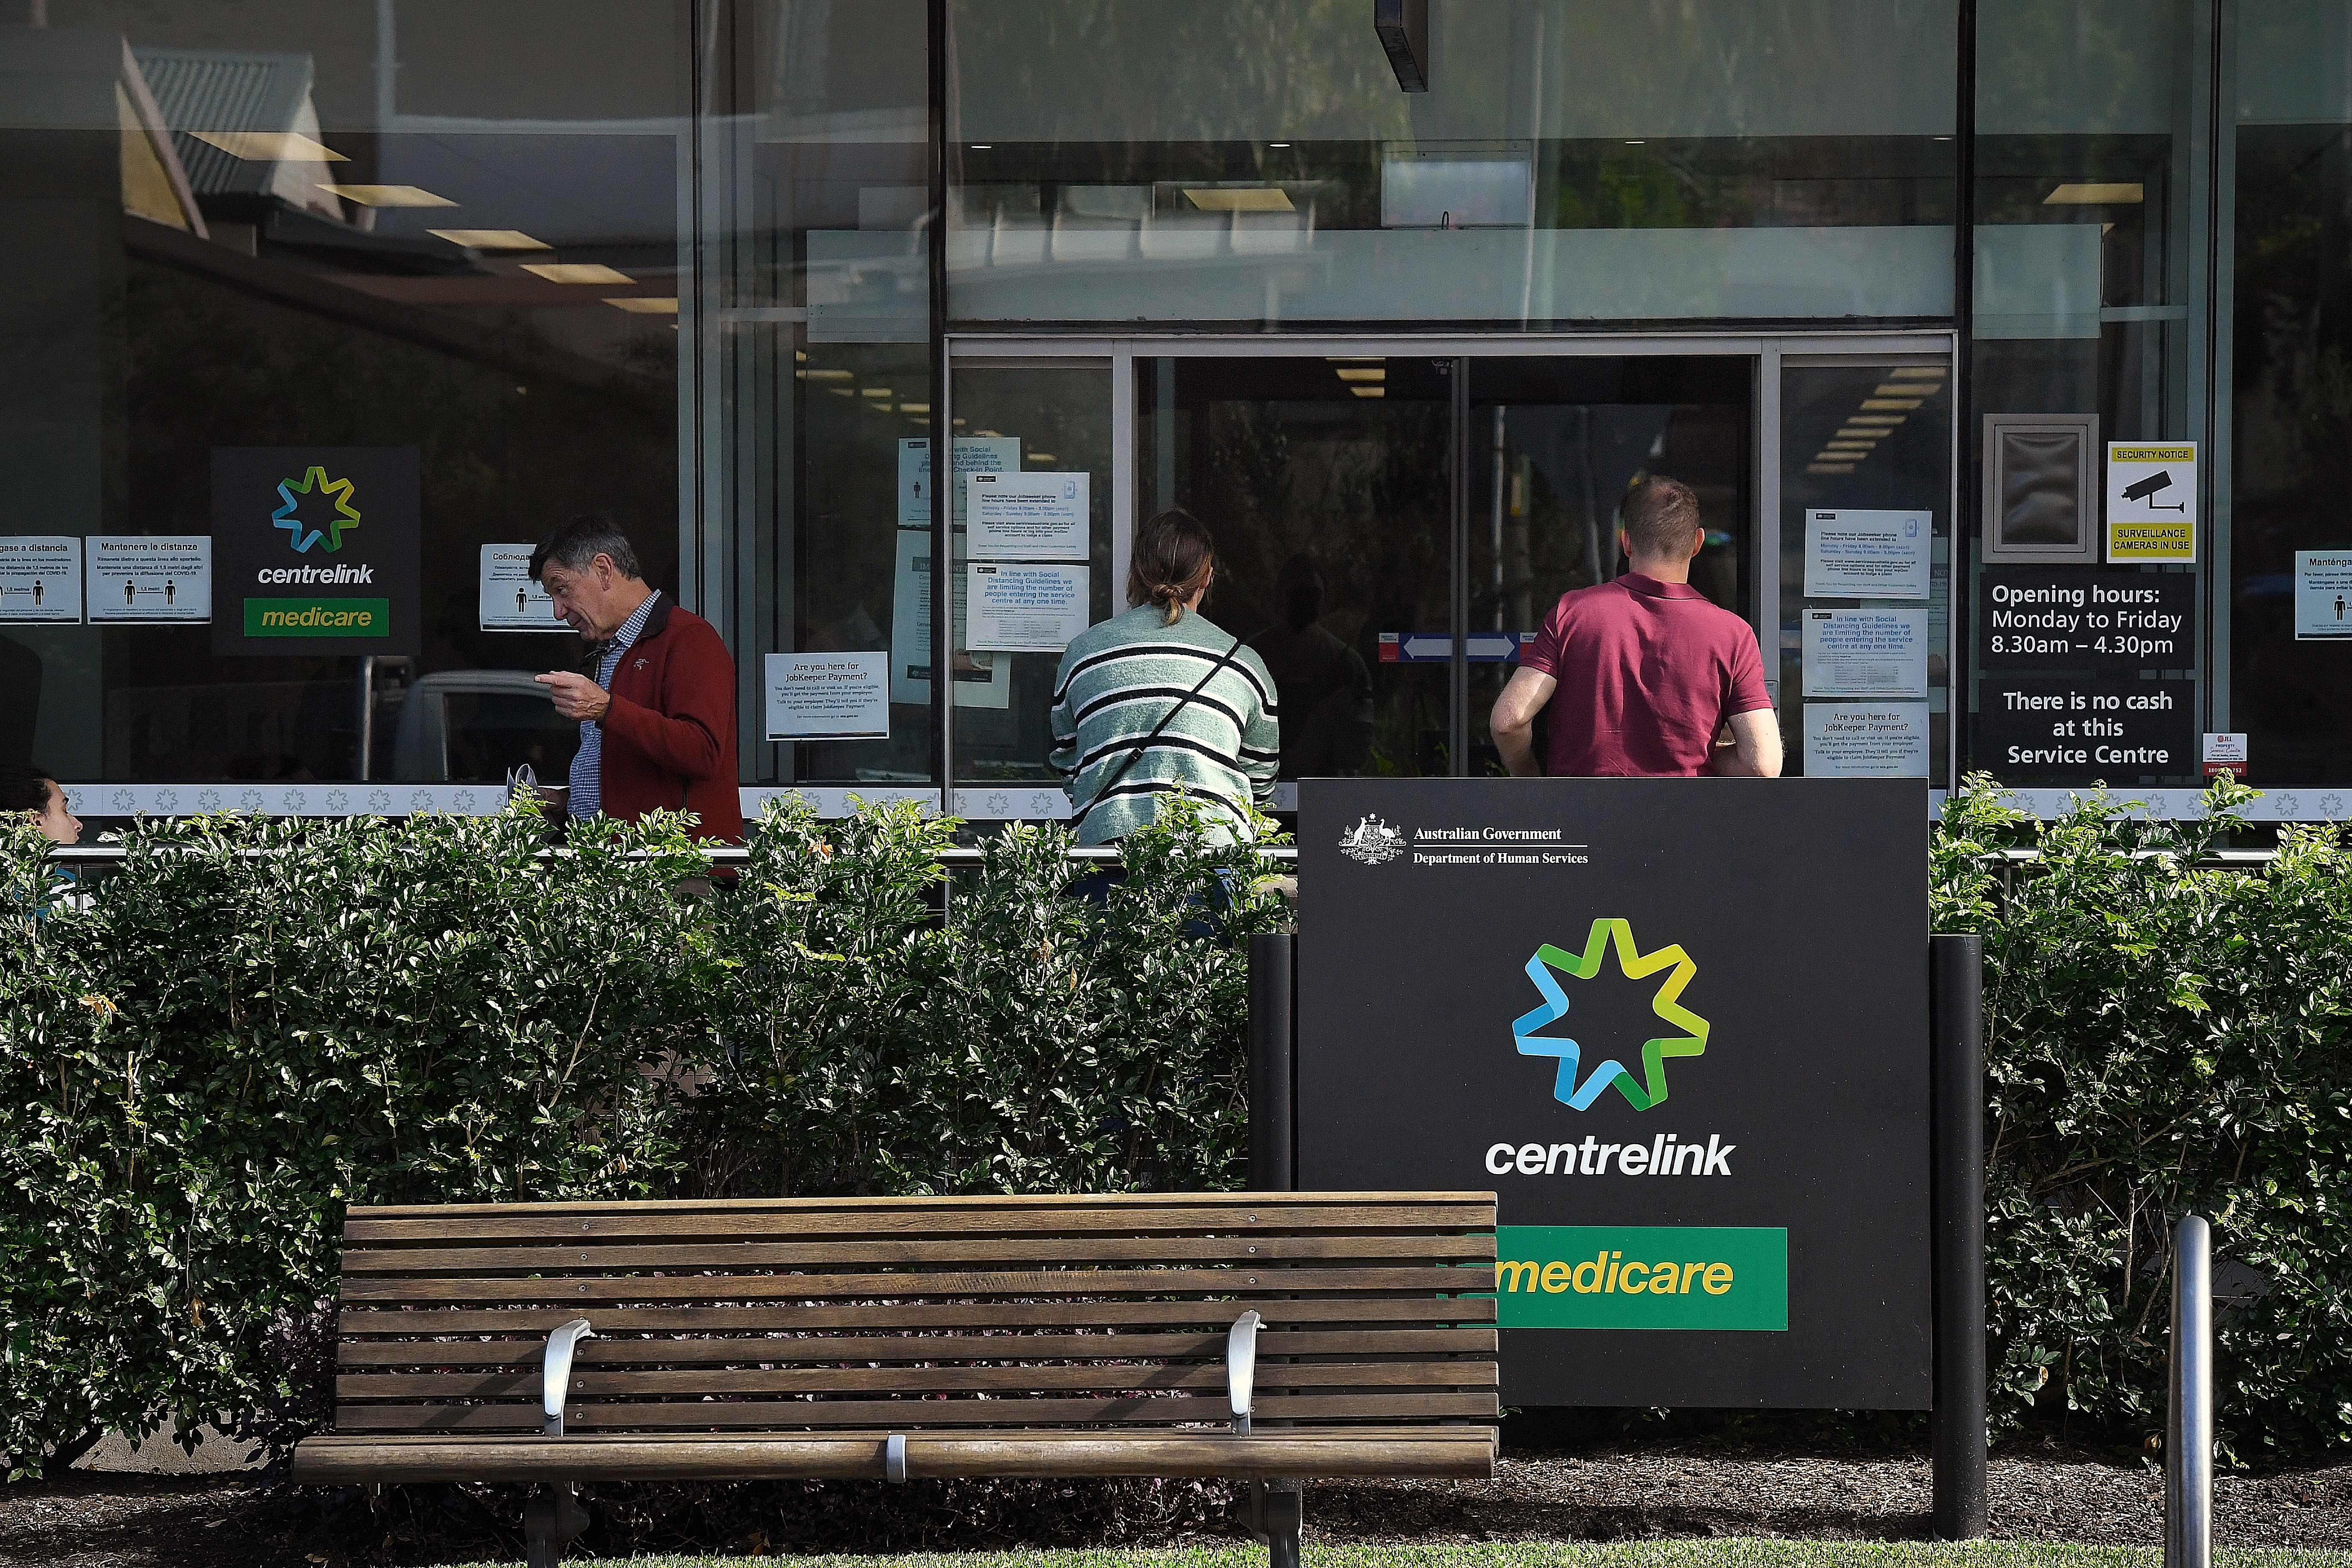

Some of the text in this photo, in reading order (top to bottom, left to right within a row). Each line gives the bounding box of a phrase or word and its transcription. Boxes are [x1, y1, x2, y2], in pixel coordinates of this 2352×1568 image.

[2118, 529, 2185, 537] SURVEILLANCE
[2114, 541, 2157, 549] CAMERAS
[2172, 541, 2189, 549] USE
[259, 564, 374, 583] centrelink
[1993, 585, 2159, 607] Opening hours:
[263, 607, 371, 626] medicare
[1993, 610, 2181, 632] Monday to Friday
[1992, 636, 2068, 653] 8.30am
[2094, 636, 2172, 657] 4.30pm
[786, 673, 867, 682] JobKeeper Payment?
[2003, 692, 2172, 709] There is no cash
[1825, 724, 1908, 732] JobKeeper Payment?
[2054, 718, 2123, 736] at this
[2008, 745, 2168, 763] Service Centre
[1414, 828, 1561, 839] Australian Government
[1413, 853, 1588, 866] Department of Human Services
[1486, 1134, 1736, 1175] centrelink
[1495, 1250, 1733, 1294] medicare
